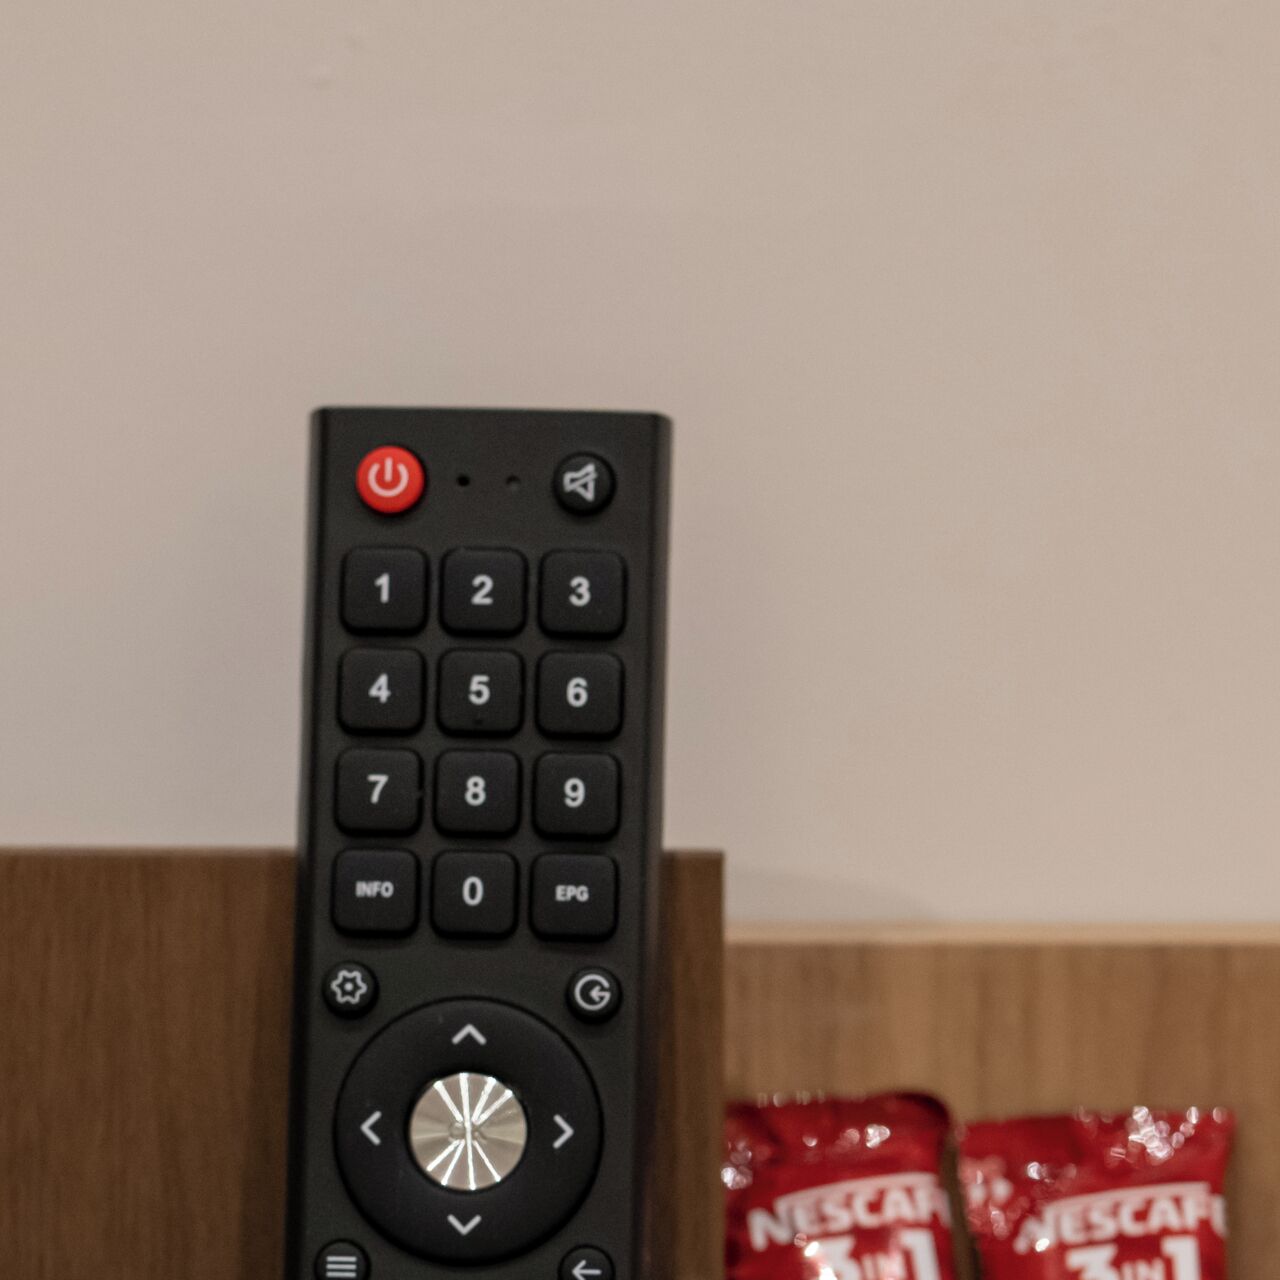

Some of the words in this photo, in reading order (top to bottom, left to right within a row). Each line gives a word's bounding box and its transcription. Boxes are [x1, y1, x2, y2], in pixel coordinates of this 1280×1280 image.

[375, 573, 390, 603] 1
[471, 574, 494, 605] 2
[569, 576, 591, 607] 3
[368, 673, 391, 703] 4
[468, 674, 491, 705] 5
[566, 676, 588, 708] 6
[367, 774, 389, 804] 7
[464, 775, 486, 806] 8
[564, 777, 586, 808] 9
[355, 880, 394, 899] INFO
[462, 875, 484, 906] 0
[555, 884, 590, 903] EPG
